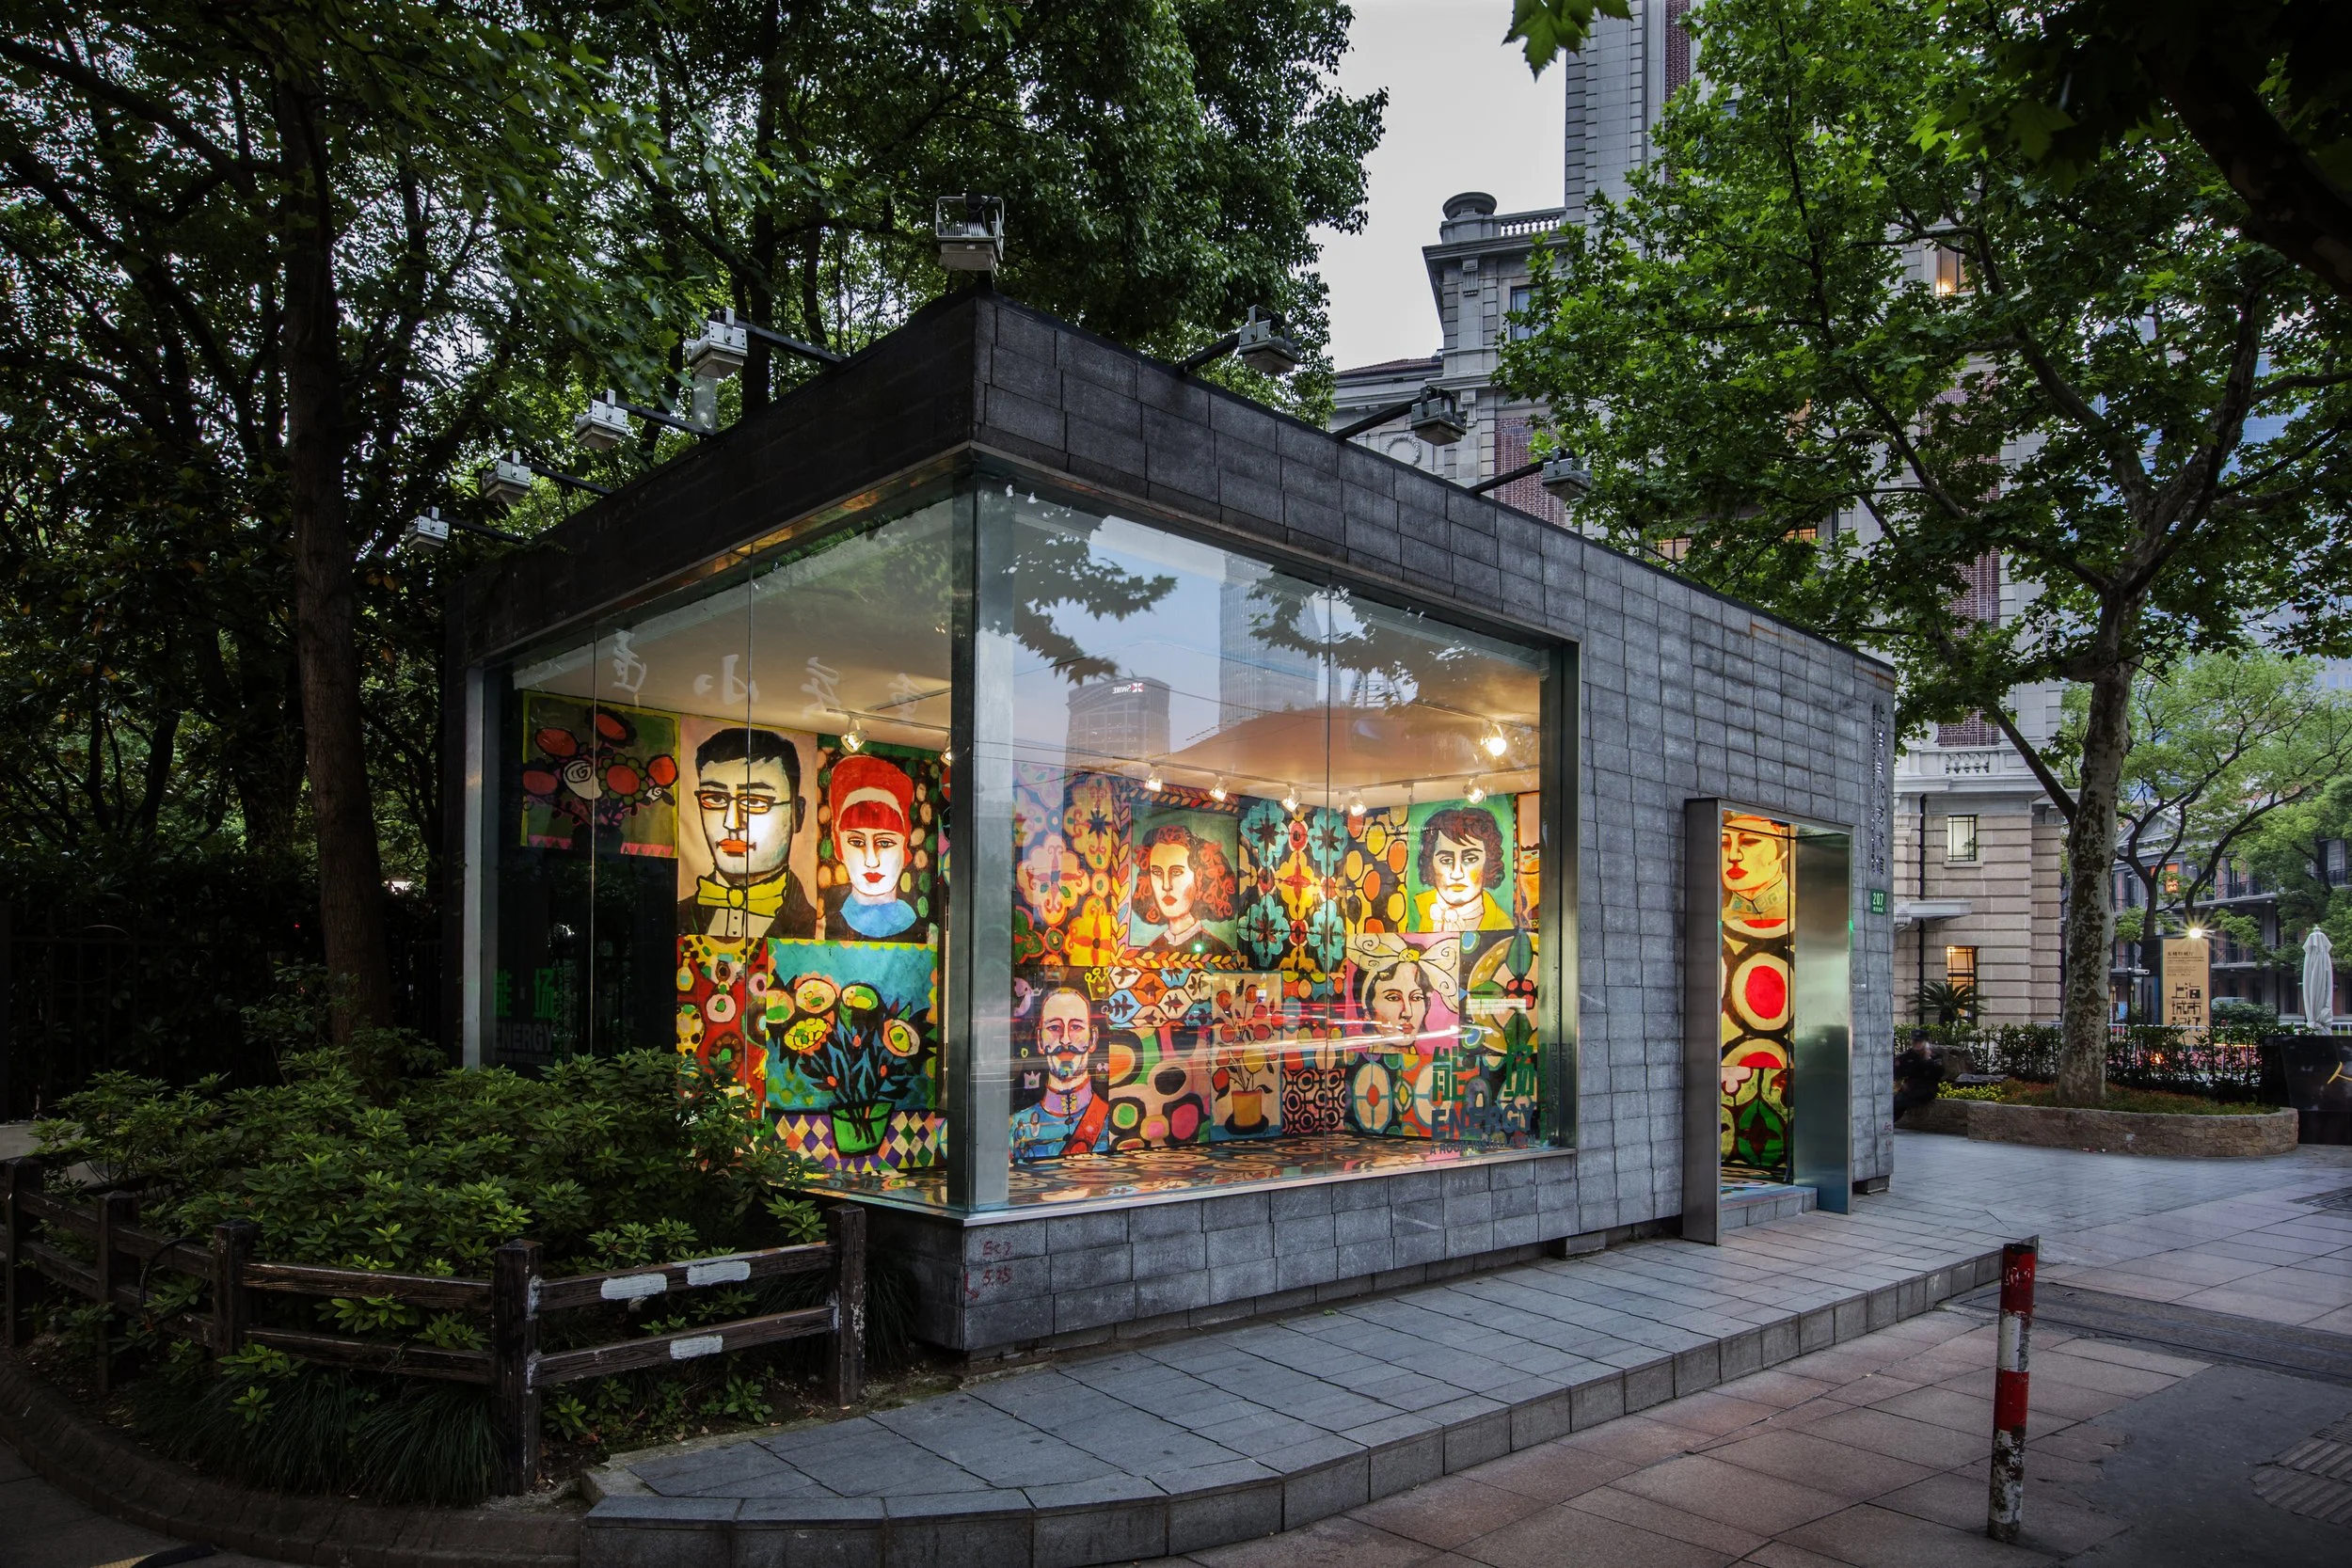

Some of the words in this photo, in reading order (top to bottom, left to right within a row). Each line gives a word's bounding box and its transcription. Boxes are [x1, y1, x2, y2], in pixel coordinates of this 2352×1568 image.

[1872, 893, 1883, 906] 207
[2171, 982, 2201, 999] 上海
[2171, 1000, 2202, 1016] 城市
[493, 1022, 555, 1052] ENERGY
[1432, 1102, 1536, 1141] ENERGY
